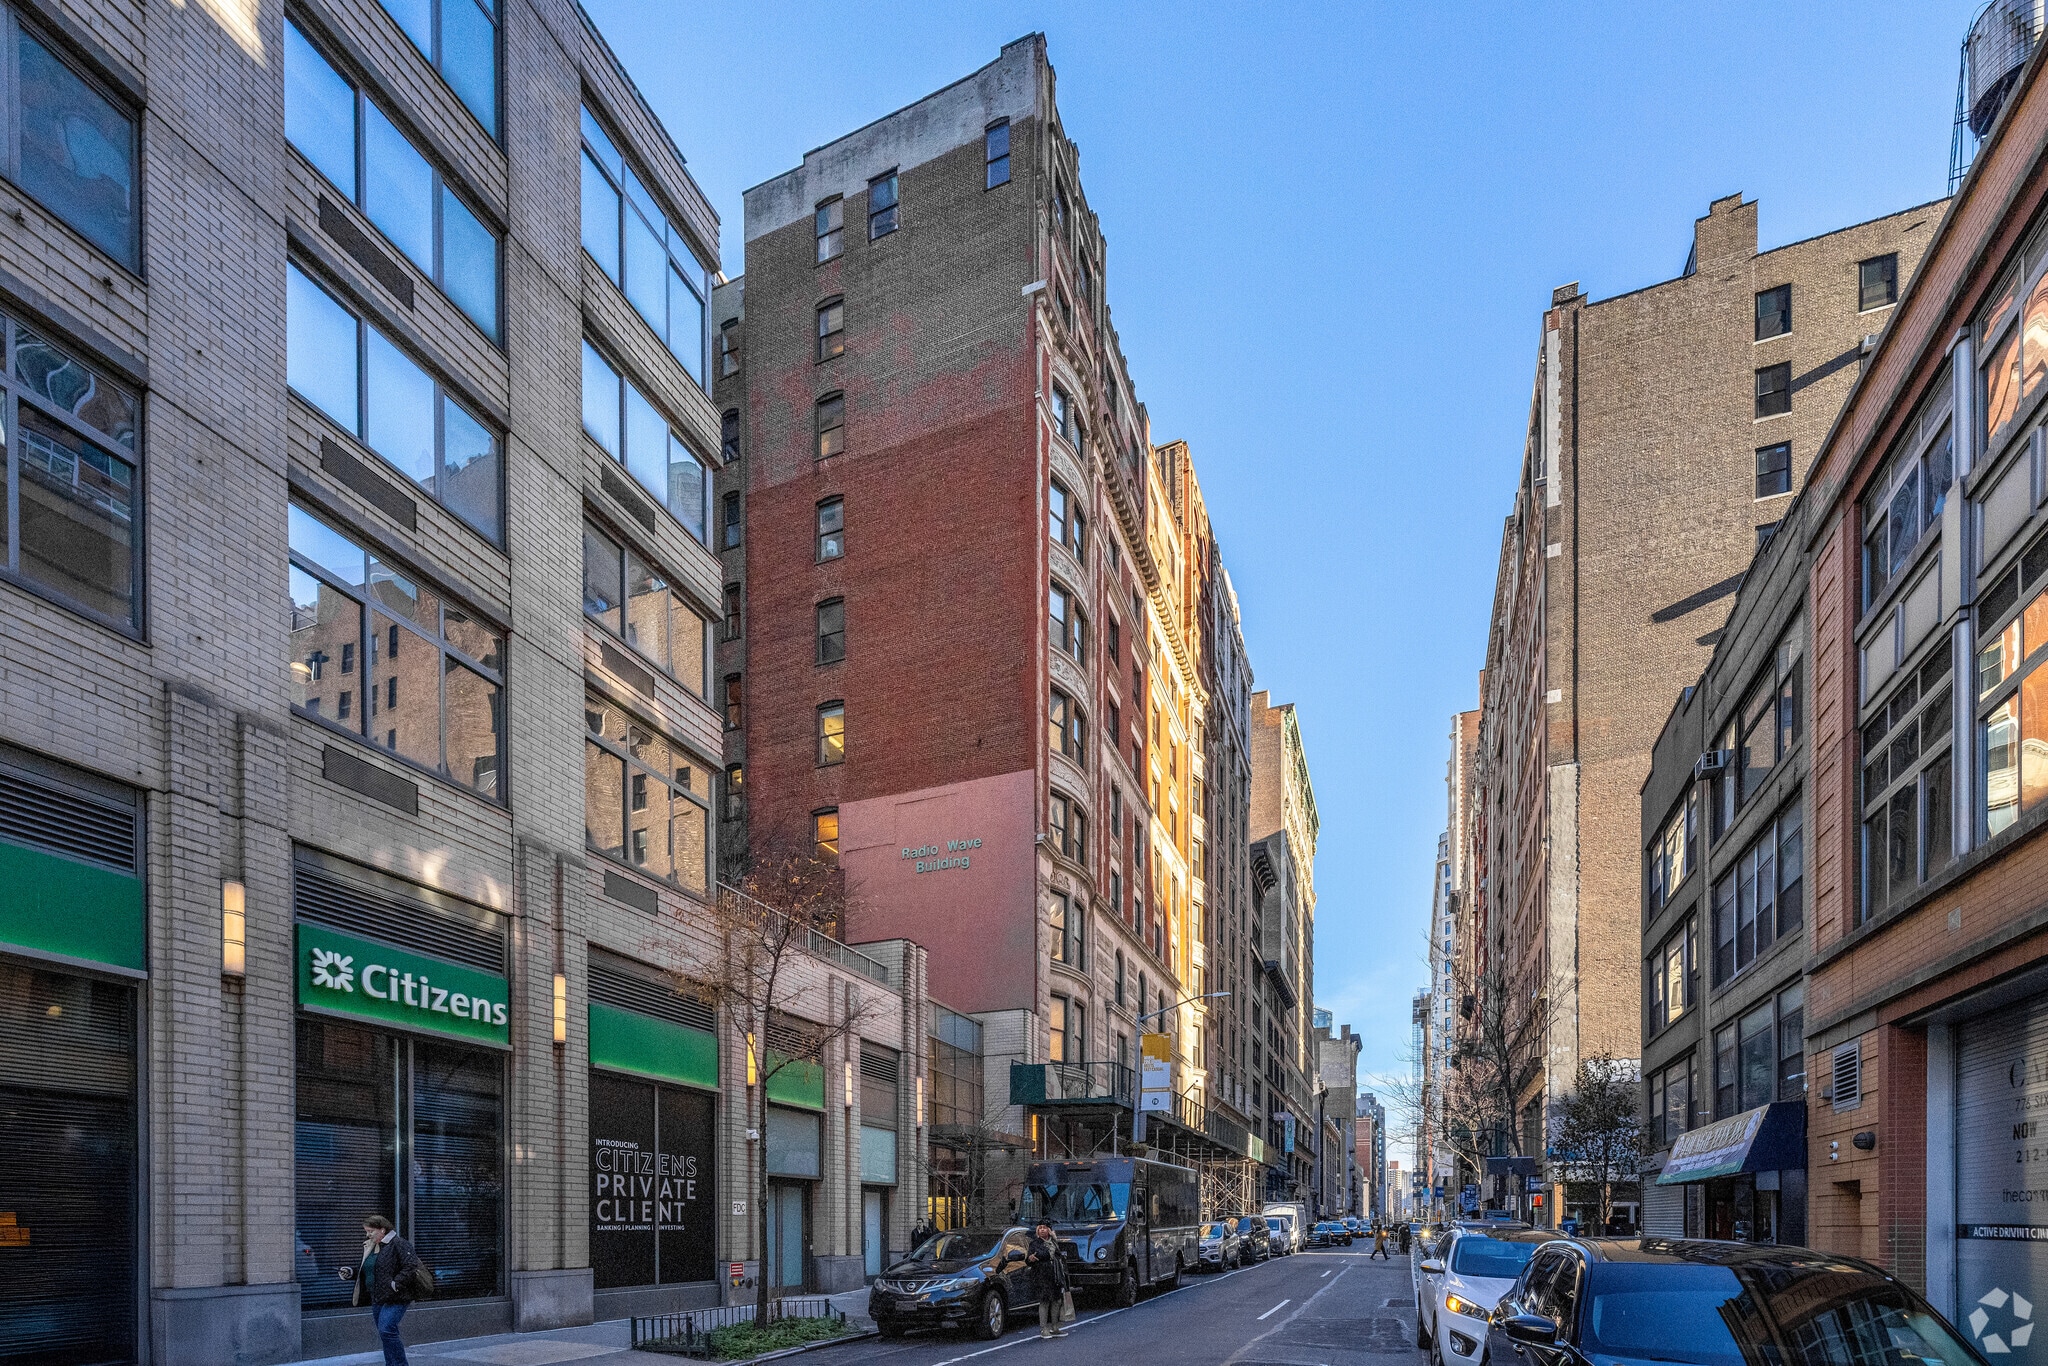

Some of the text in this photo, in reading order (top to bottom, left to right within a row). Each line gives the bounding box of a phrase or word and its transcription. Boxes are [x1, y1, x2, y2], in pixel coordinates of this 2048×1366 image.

[901, 838, 982, 860] Radio Wave
[915, 855, 970, 874] Building
[361, 964, 507, 1026] Citizens
[2013, 1121, 2038, 1141] NOW
[595, 1138, 639, 1150] INTRODUCING
[595, 1147, 697, 1178] CITIZENS
[596, 1173, 697, 1200] PRIVATE
[596, 1199, 686, 1223] CLIENT
[733, 1203, 746, 1213] FDC
[1973, 1226, 1998, 1238] ACTIVE
